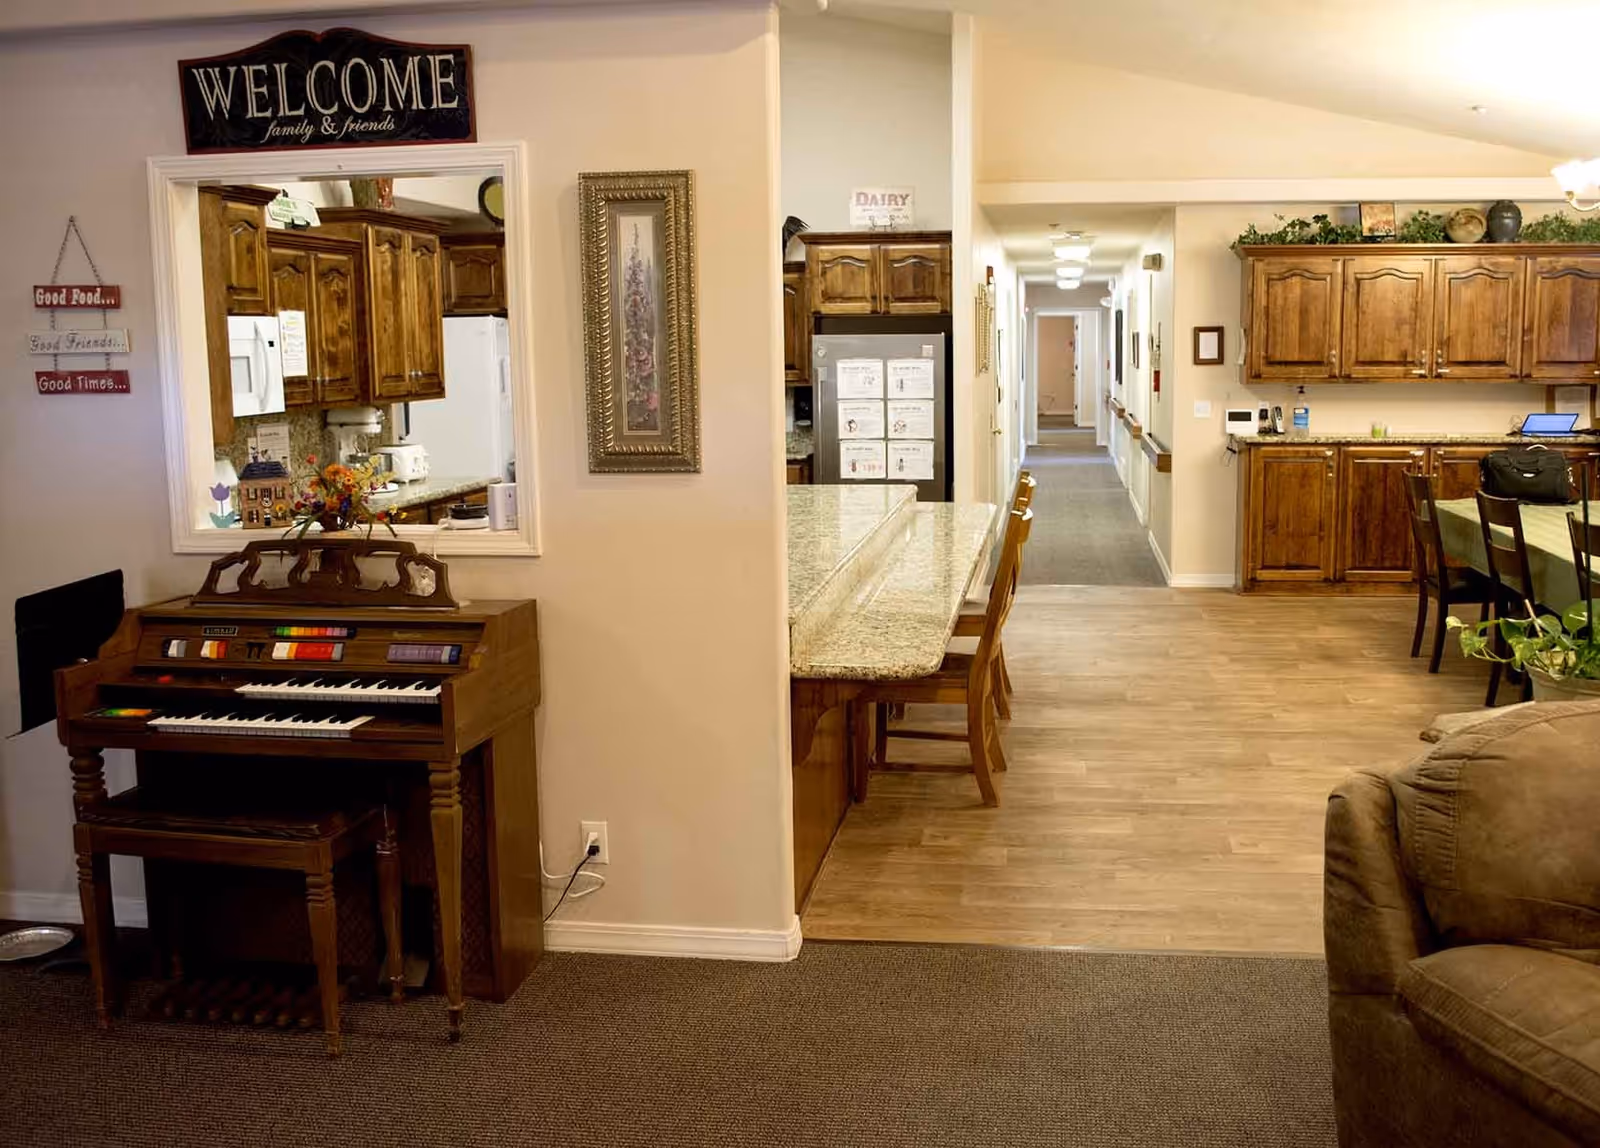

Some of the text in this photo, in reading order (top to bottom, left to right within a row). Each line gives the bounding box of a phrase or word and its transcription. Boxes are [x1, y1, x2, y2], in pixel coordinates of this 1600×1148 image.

[191, 53, 459, 121] WELCOME
[259, 114, 395, 144] family & friends
[855, 191, 910, 207] DAIRY
[35, 287, 115, 305] Good Food...
[30, 335, 61, 352] Good
[39, 375, 127, 391] Good Times...
